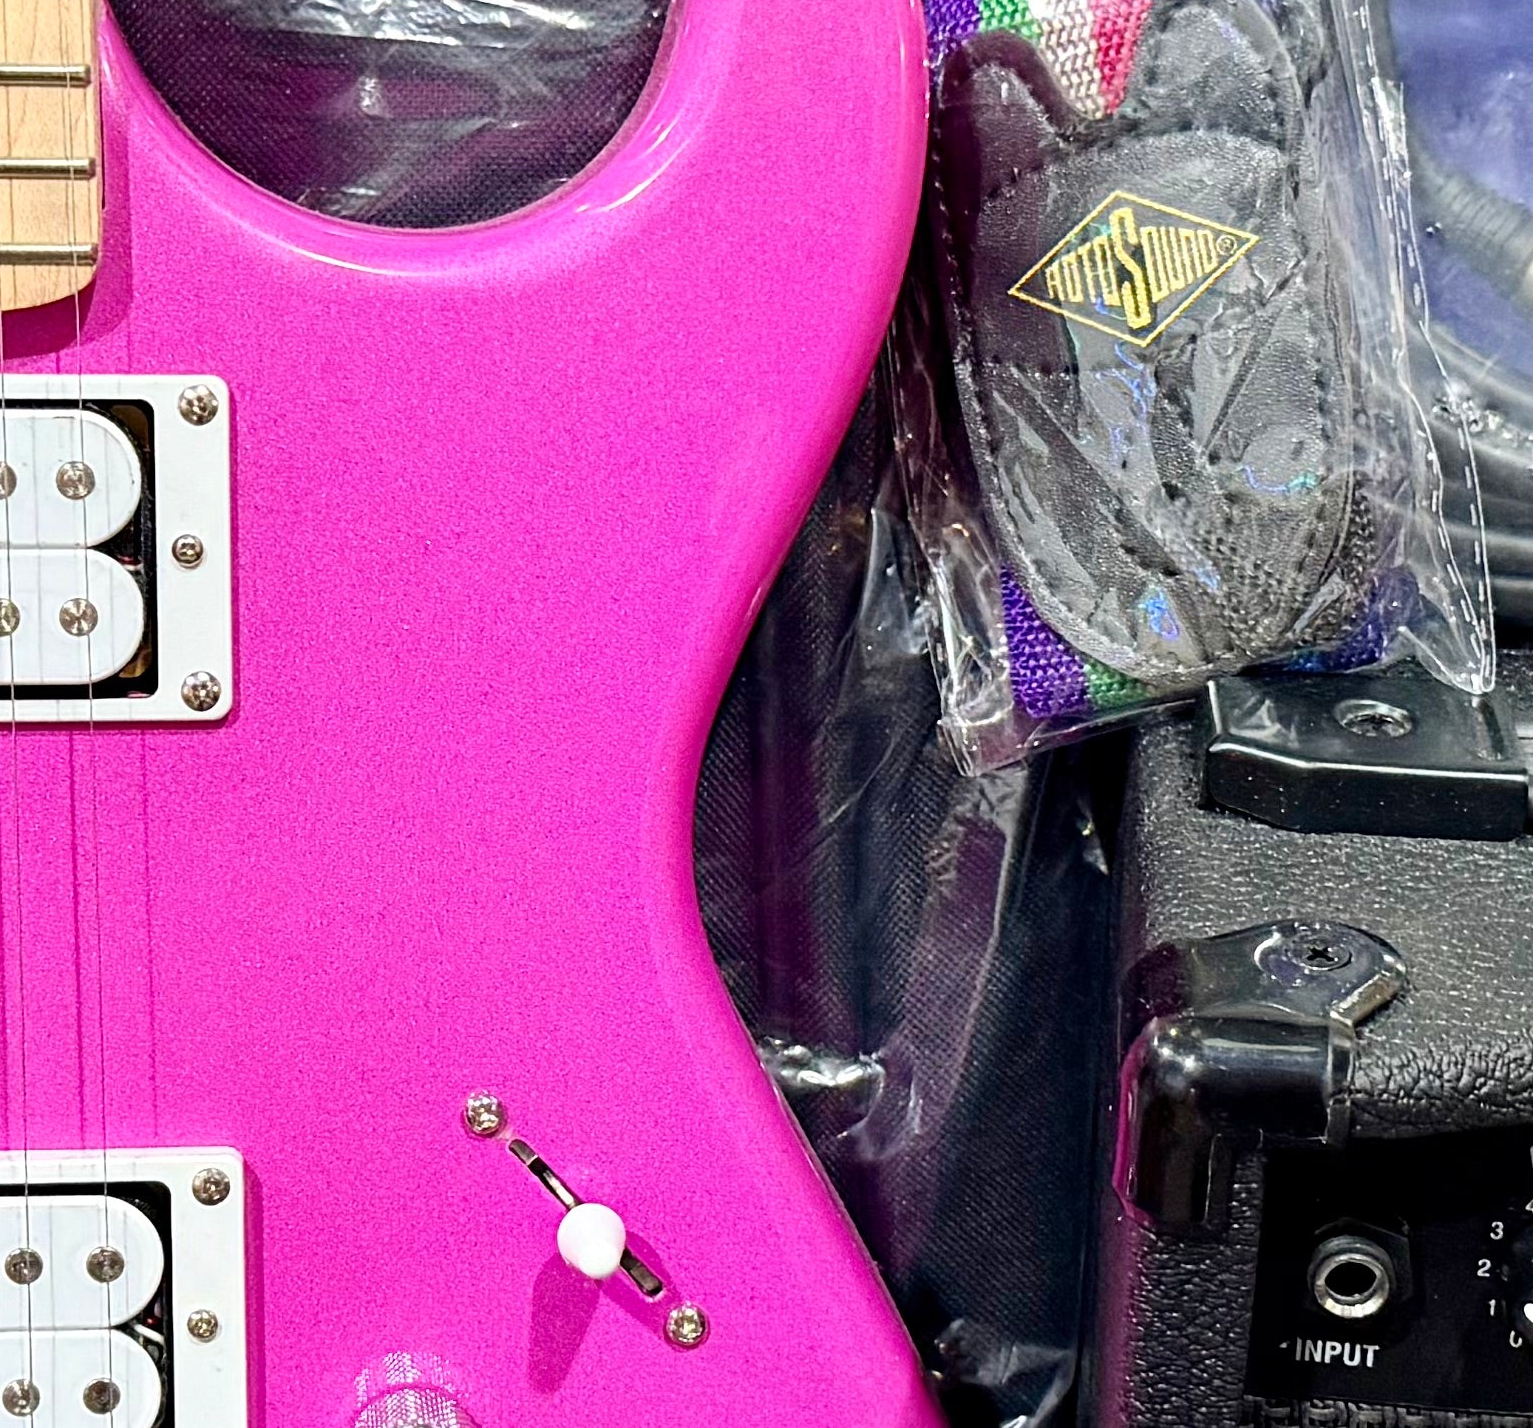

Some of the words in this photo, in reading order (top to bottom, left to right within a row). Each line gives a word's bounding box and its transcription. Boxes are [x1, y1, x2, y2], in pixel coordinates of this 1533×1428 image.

[1489, 1220, 1505, 1241] 3
[1476, 1258, 1492, 1278] 2
[1487, 1298, 1497, 1317] 1
[1295, 1336, 1381, 1368] INPUT
